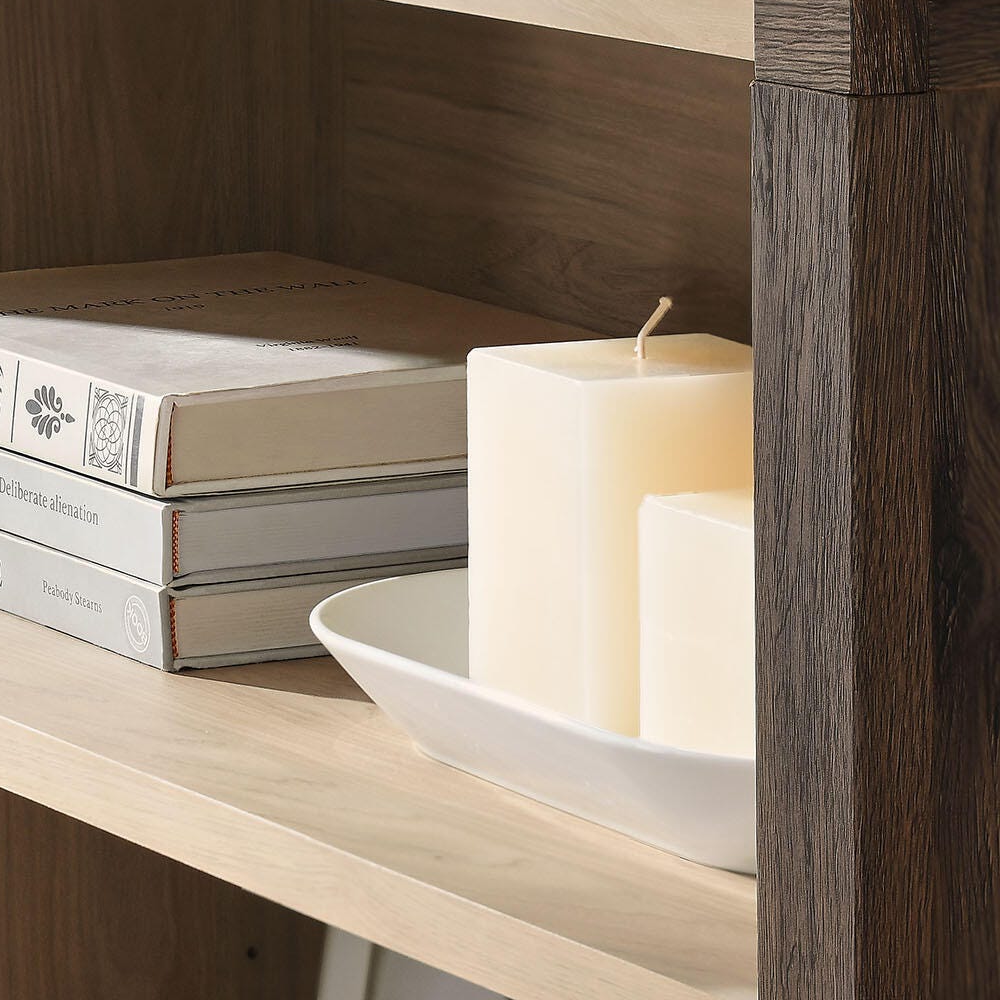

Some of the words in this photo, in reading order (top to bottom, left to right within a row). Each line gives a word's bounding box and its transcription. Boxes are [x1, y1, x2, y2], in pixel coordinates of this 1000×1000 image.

[50, 299, 144, 311] MARK
[152, 294, 200, 302] ON
[206, 287, 274, 297] THE
[277, 281, 367, 290] WALL
[0, 476, 47, 508] Deliberate
[50, 494, 99, 525] alienation
[42, 579, 73, 605] Peabody
[75, 591, 102, 613] Stearns
